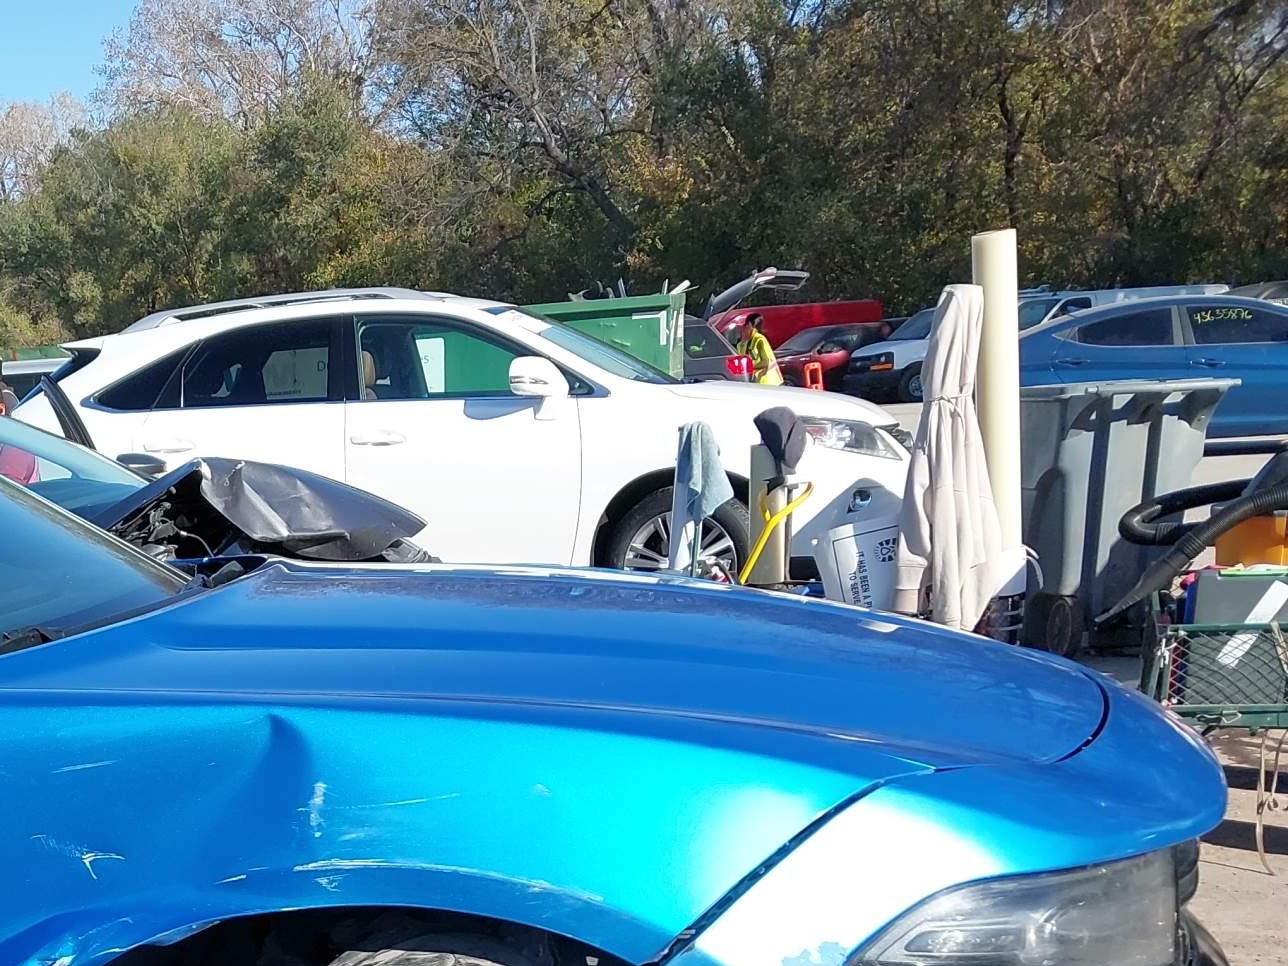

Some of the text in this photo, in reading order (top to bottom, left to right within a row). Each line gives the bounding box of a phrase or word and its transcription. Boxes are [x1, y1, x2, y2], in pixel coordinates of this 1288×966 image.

[857, 560, 868, 574] HAS
[849, 571, 861, 605] TO SERVE
[859, 574, 871, 593] BEEN
